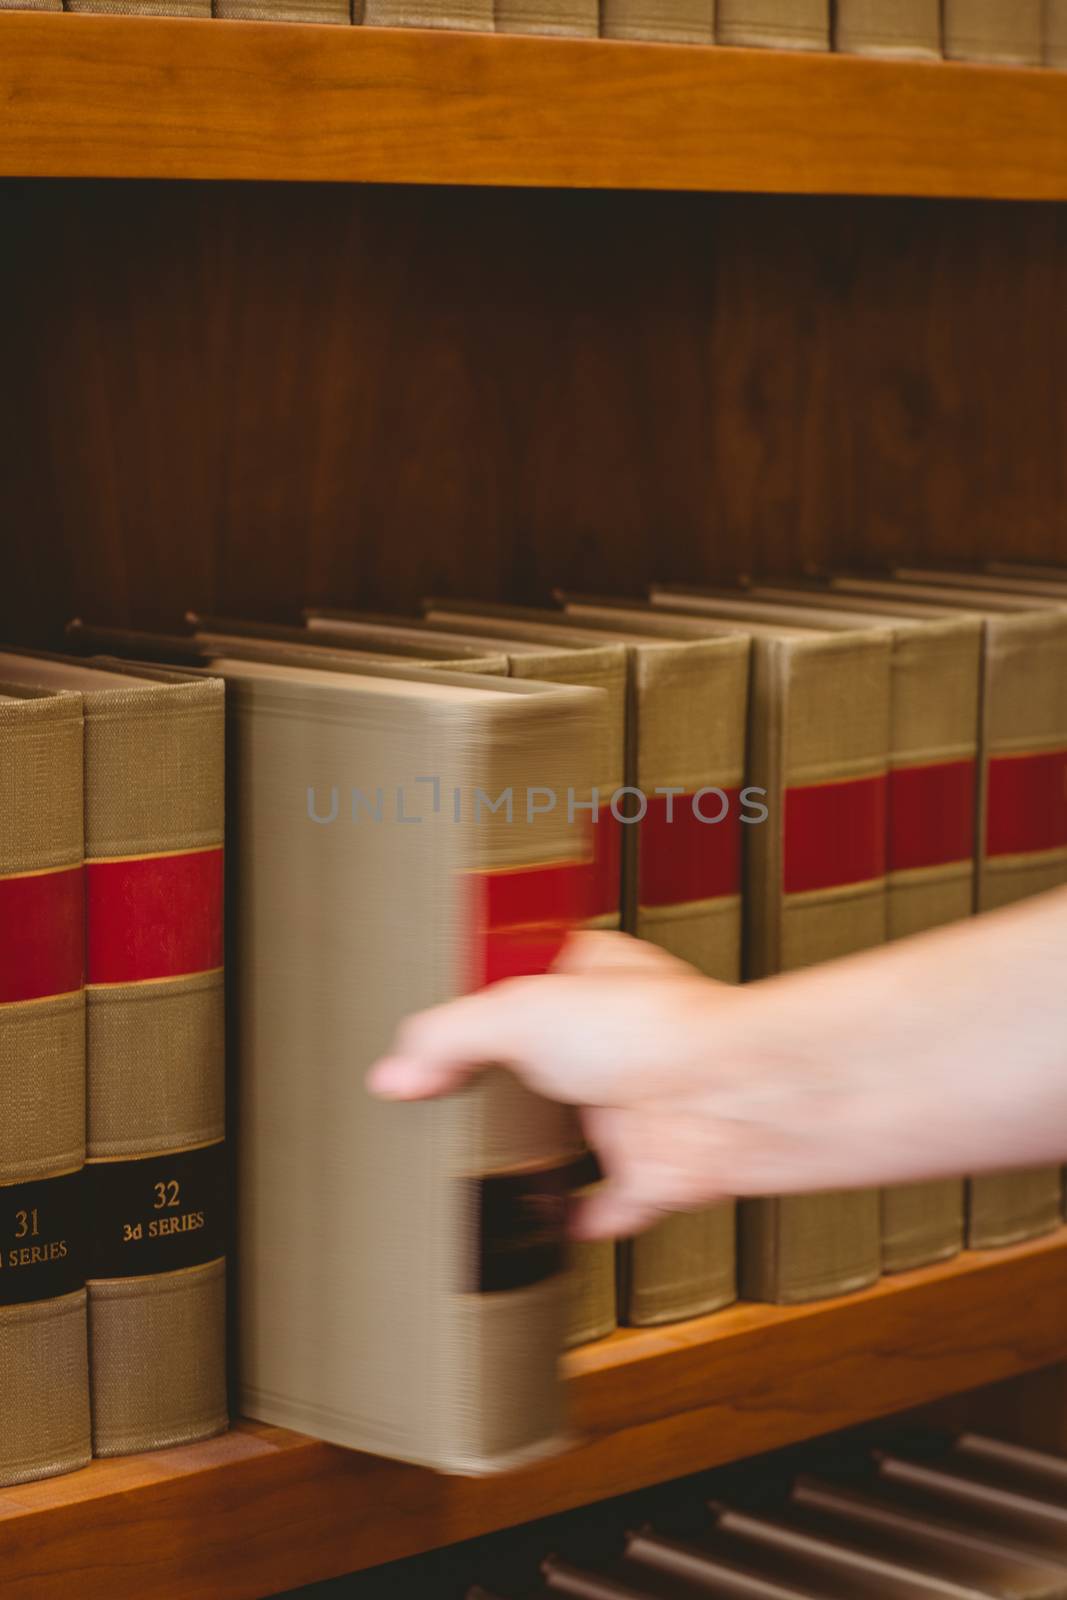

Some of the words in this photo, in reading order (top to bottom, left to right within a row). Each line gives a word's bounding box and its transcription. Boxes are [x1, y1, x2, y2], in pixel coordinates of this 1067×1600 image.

[153, 1180, 180, 1209] 32
[15, 1208, 40, 1238] 31
[123, 1224, 142, 1242] 3d
[148, 1211, 205, 1237] SERIES
[8, 1240, 68, 1267] SERIES
